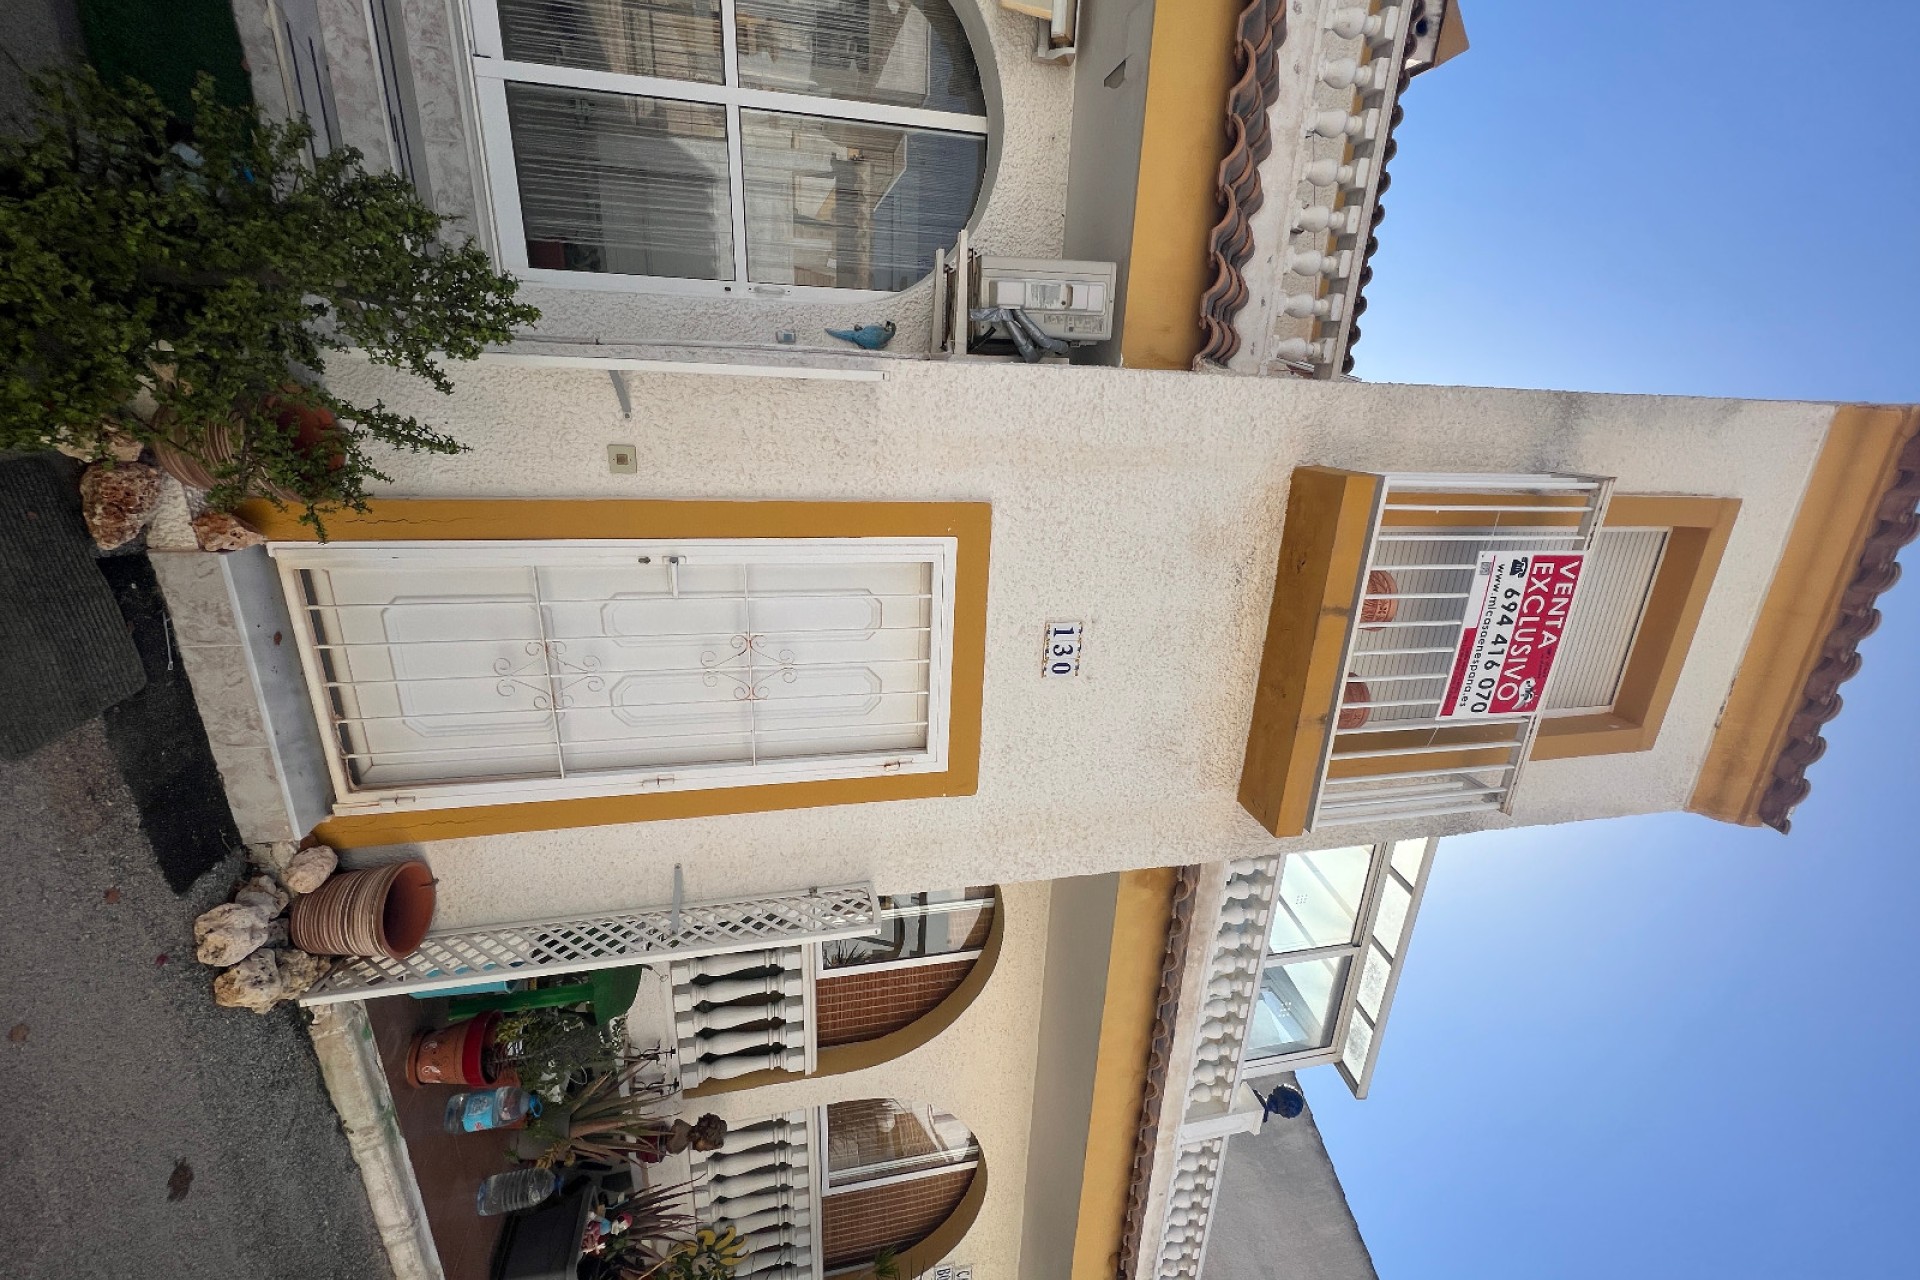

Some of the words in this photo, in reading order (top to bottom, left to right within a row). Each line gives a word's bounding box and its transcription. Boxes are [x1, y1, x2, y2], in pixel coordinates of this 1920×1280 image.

[1499, 588, 1521, 626] 694
[1537, 560, 1580, 648] VENTA
[1051, 626, 1074, 674] 130
[1483, 634, 1508, 670] 416
[1497, 562, 1555, 701] EXCLUSIVO
[1470, 677, 1496, 713] 070
